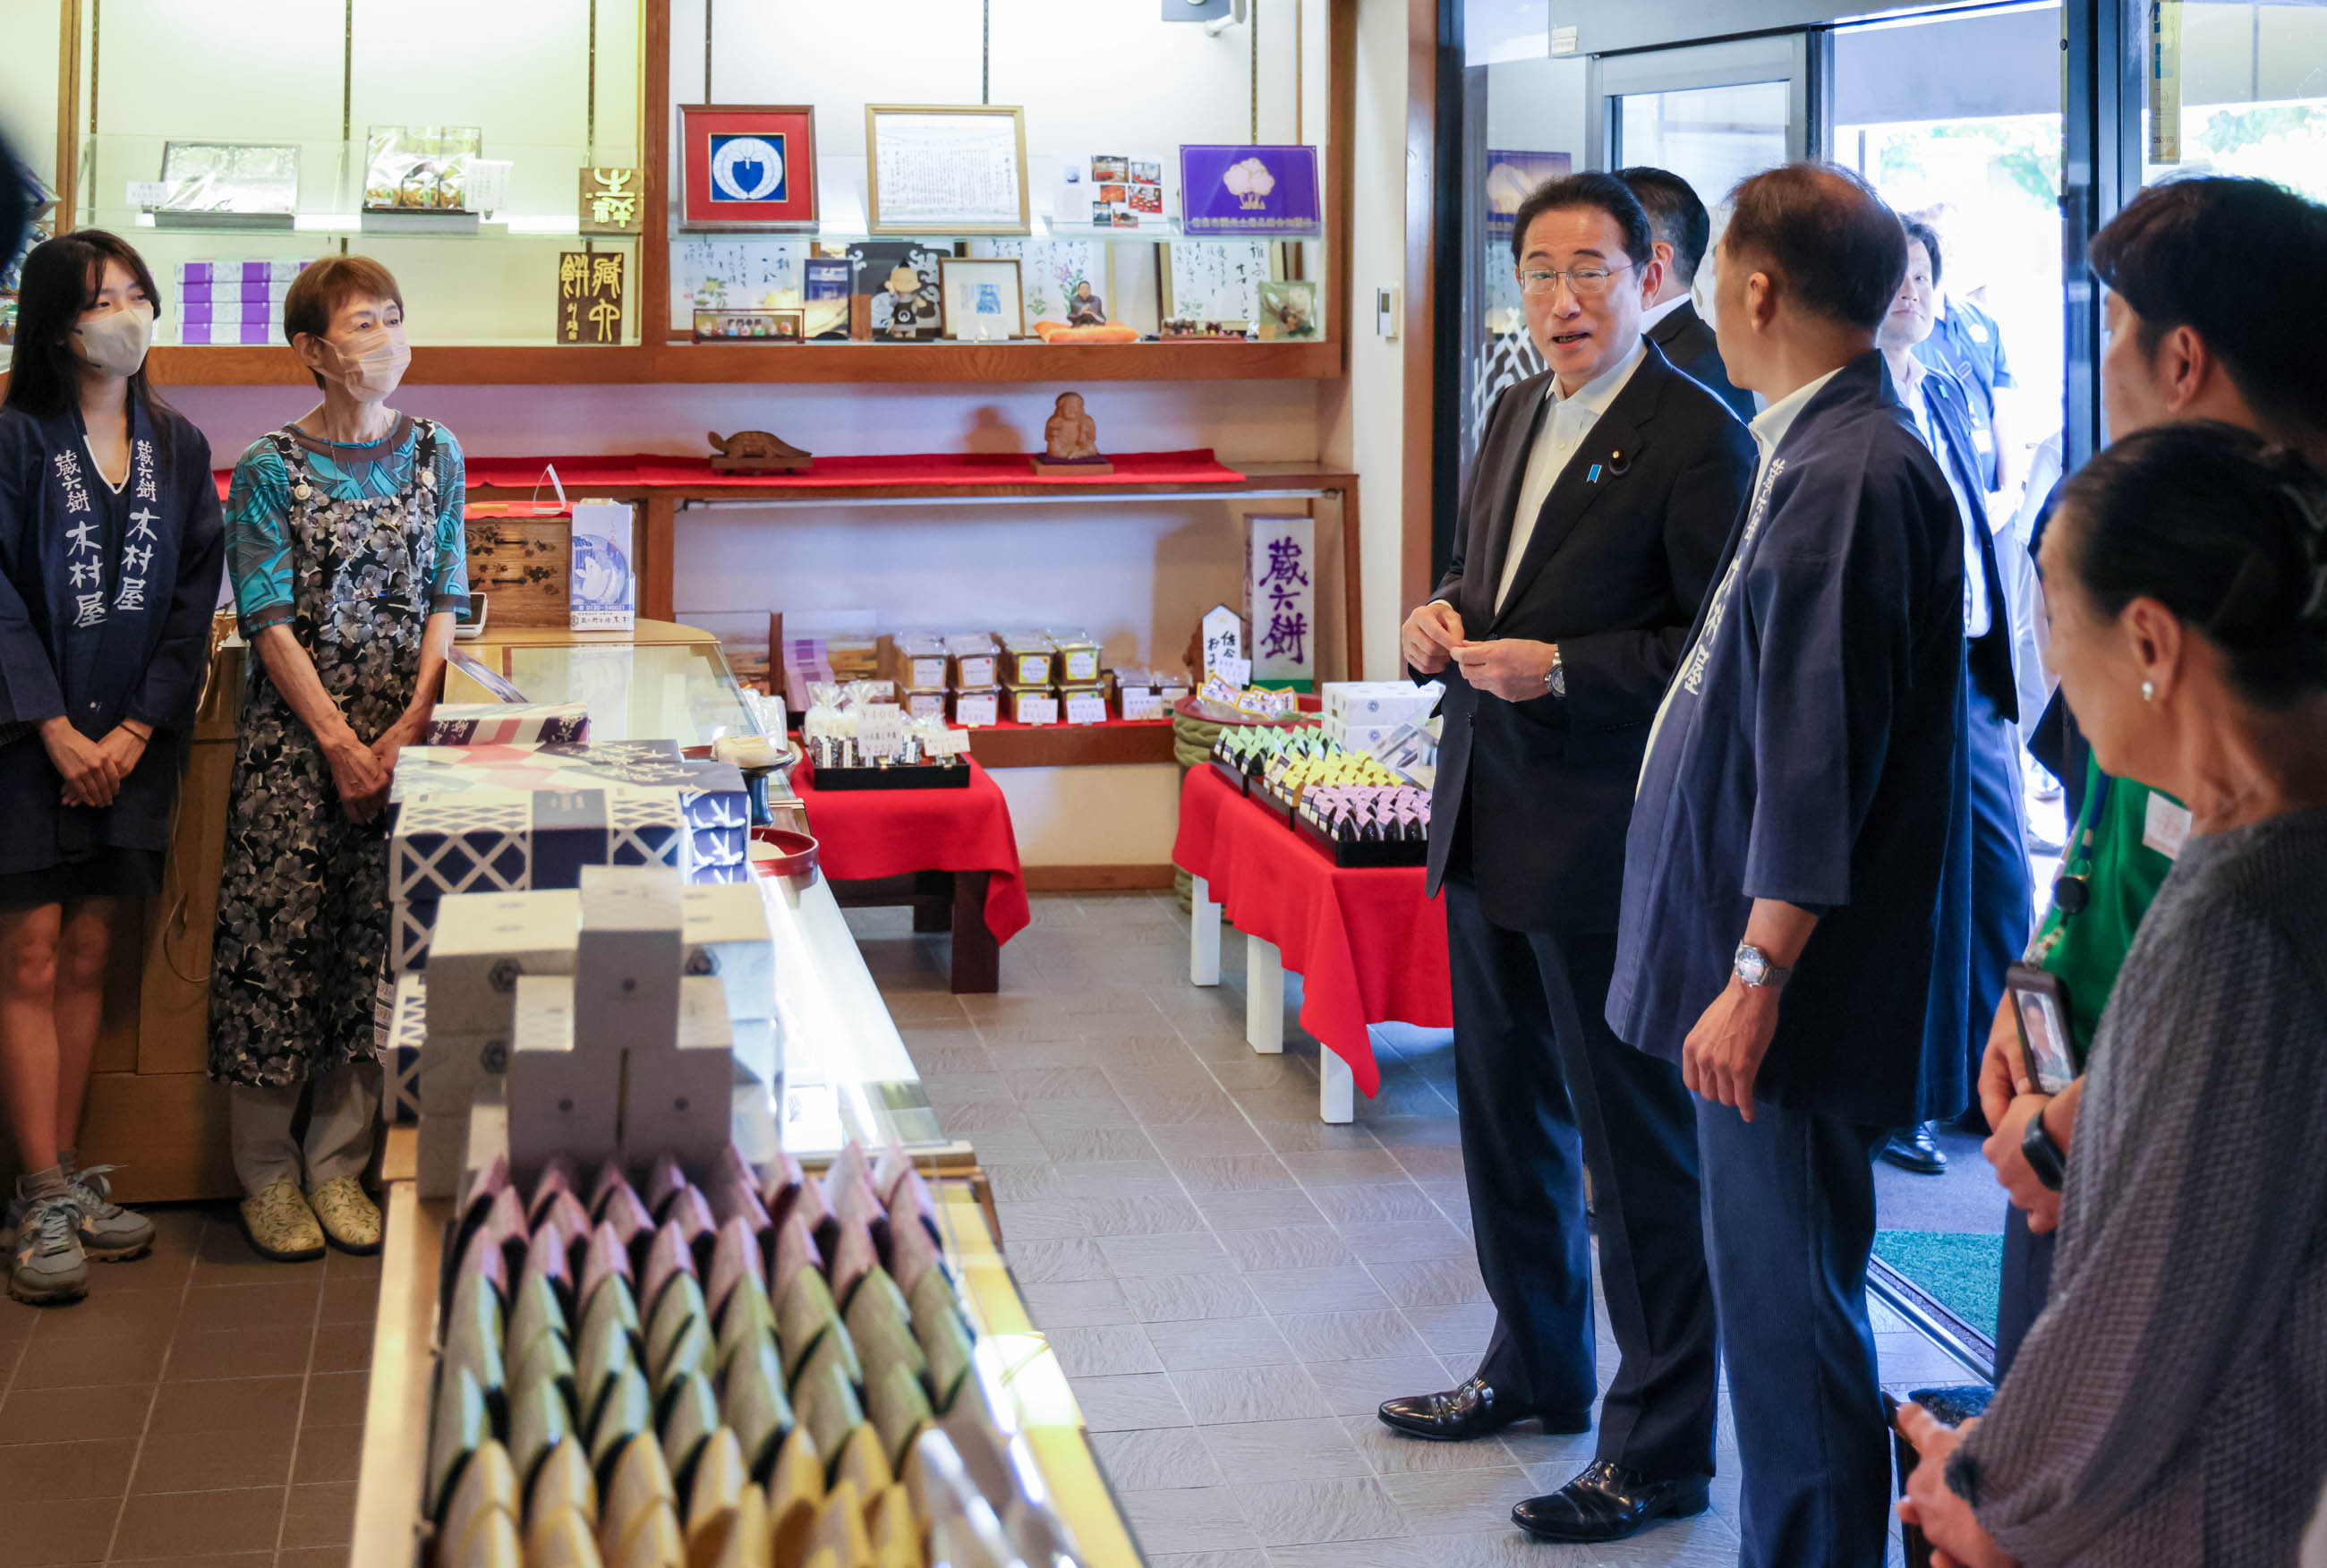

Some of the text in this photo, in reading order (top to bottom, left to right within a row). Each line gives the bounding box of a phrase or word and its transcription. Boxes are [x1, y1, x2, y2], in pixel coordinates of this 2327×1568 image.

[54, 449, 107, 627] 蔵六餅 木村屋
[113, 439, 161, 610] 蔵六餅 木村屋
[1258, 536, 1308, 665] 蔵六餅
